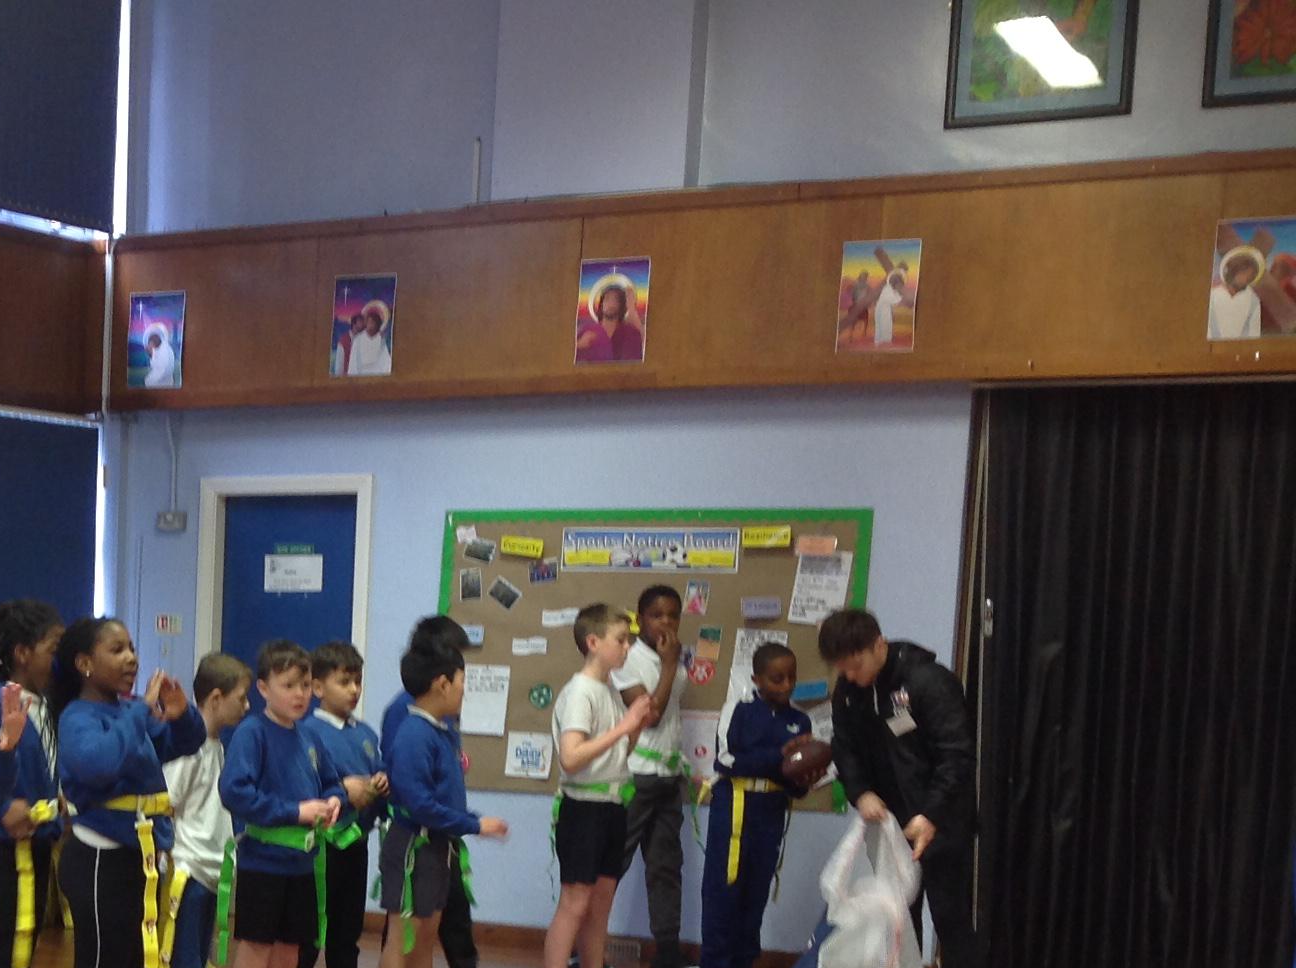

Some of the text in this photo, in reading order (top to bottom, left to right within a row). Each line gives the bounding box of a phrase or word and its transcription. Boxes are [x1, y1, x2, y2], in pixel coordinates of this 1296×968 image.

[567, 531, 734, 551] Sports Notice Board
